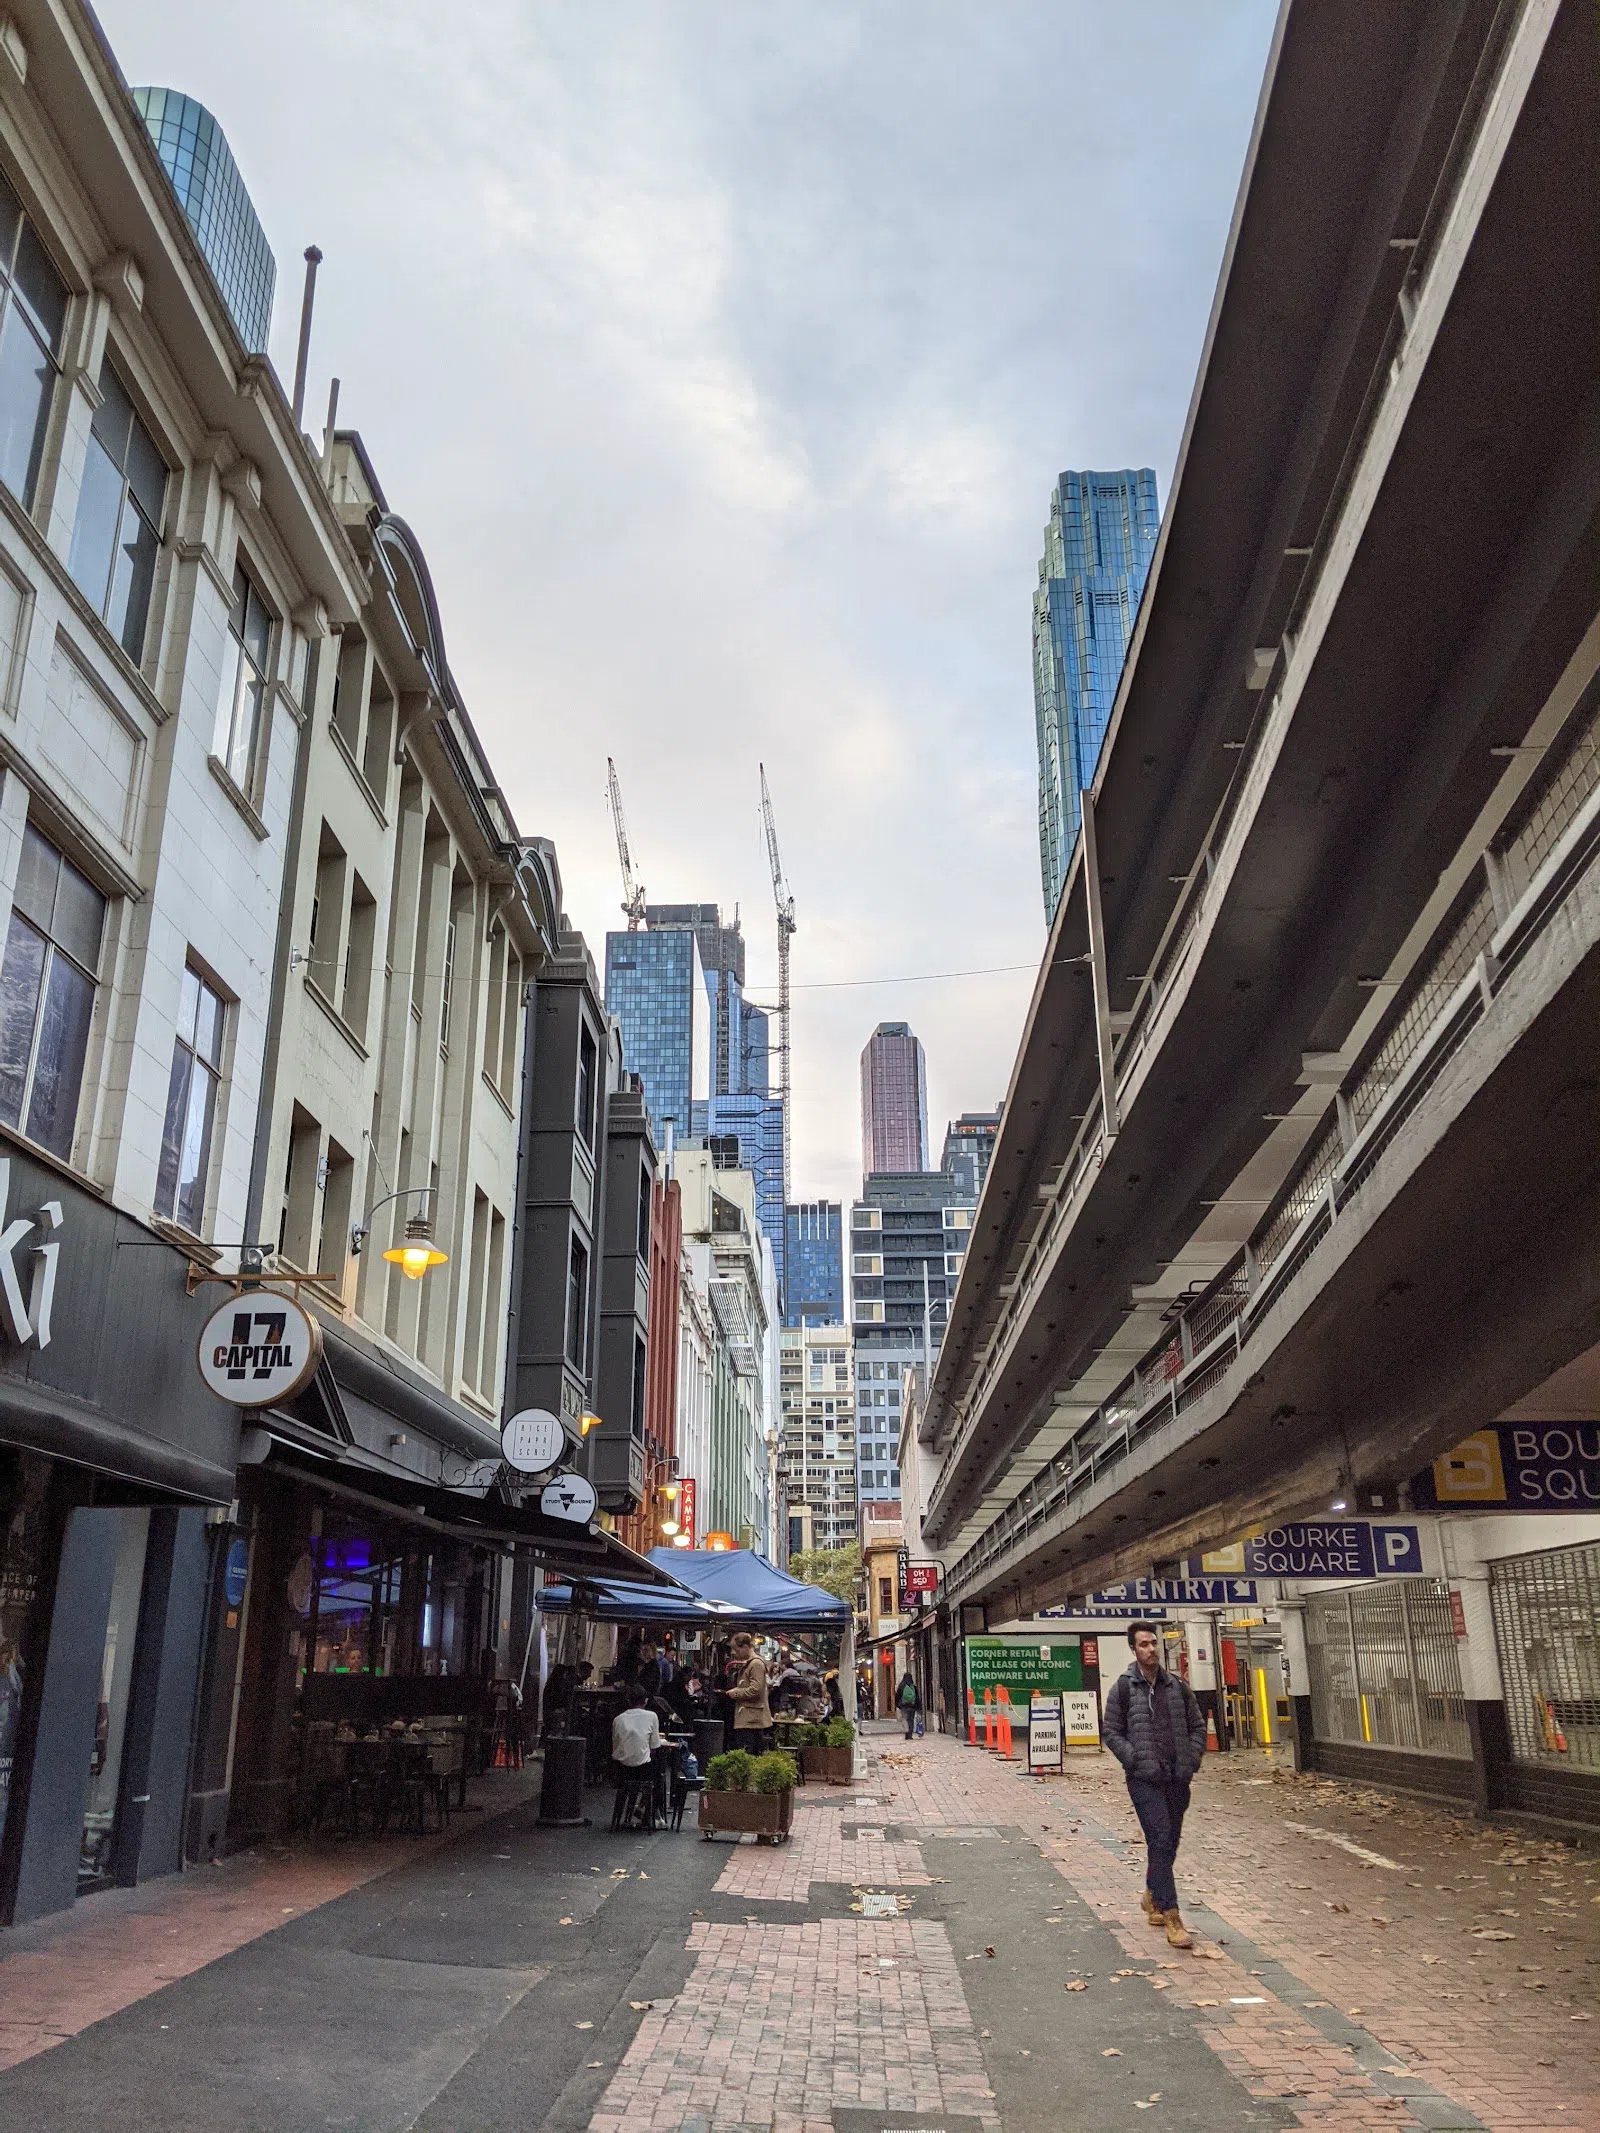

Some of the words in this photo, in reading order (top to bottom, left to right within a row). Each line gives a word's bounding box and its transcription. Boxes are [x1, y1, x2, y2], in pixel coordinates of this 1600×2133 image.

[213, 1345, 293, 1368] CAPITAL
[683, 1483, 693, 1549] CAMPA
[1252, 1528, 1358, 1547] BOURKE
[1384, 1533, 1410, 1566] P
[1253, 1552, 1361, 1572] SQUARE
[913, 1569, 925, 1577] OH
[1136, 1577, 1215, 1600] ENTRY
[971, 1649, 1008, 1658] CORNER
[1010, 1649, 1039, 1658] RETAIL
[971, 1661, 989, 1669] FOR
[992, 1661, 1018, 1669] LEASE
[1021, 1661, 1035, 1669] ON
[1038, 1660, 1071, 1669] ICONIC
[972, 1671, 1023, 1680] HARDWARE
[1025, 1671, 1049, 1680] LANE
[1071, 1702, 1089, 1711] OPEN
[1071, 1722, 1093, 1731] HOURS
[1034, 1731, 1057, 1740] PARKING
[1032, 1744, 1059, 1753] AVAILABLE
